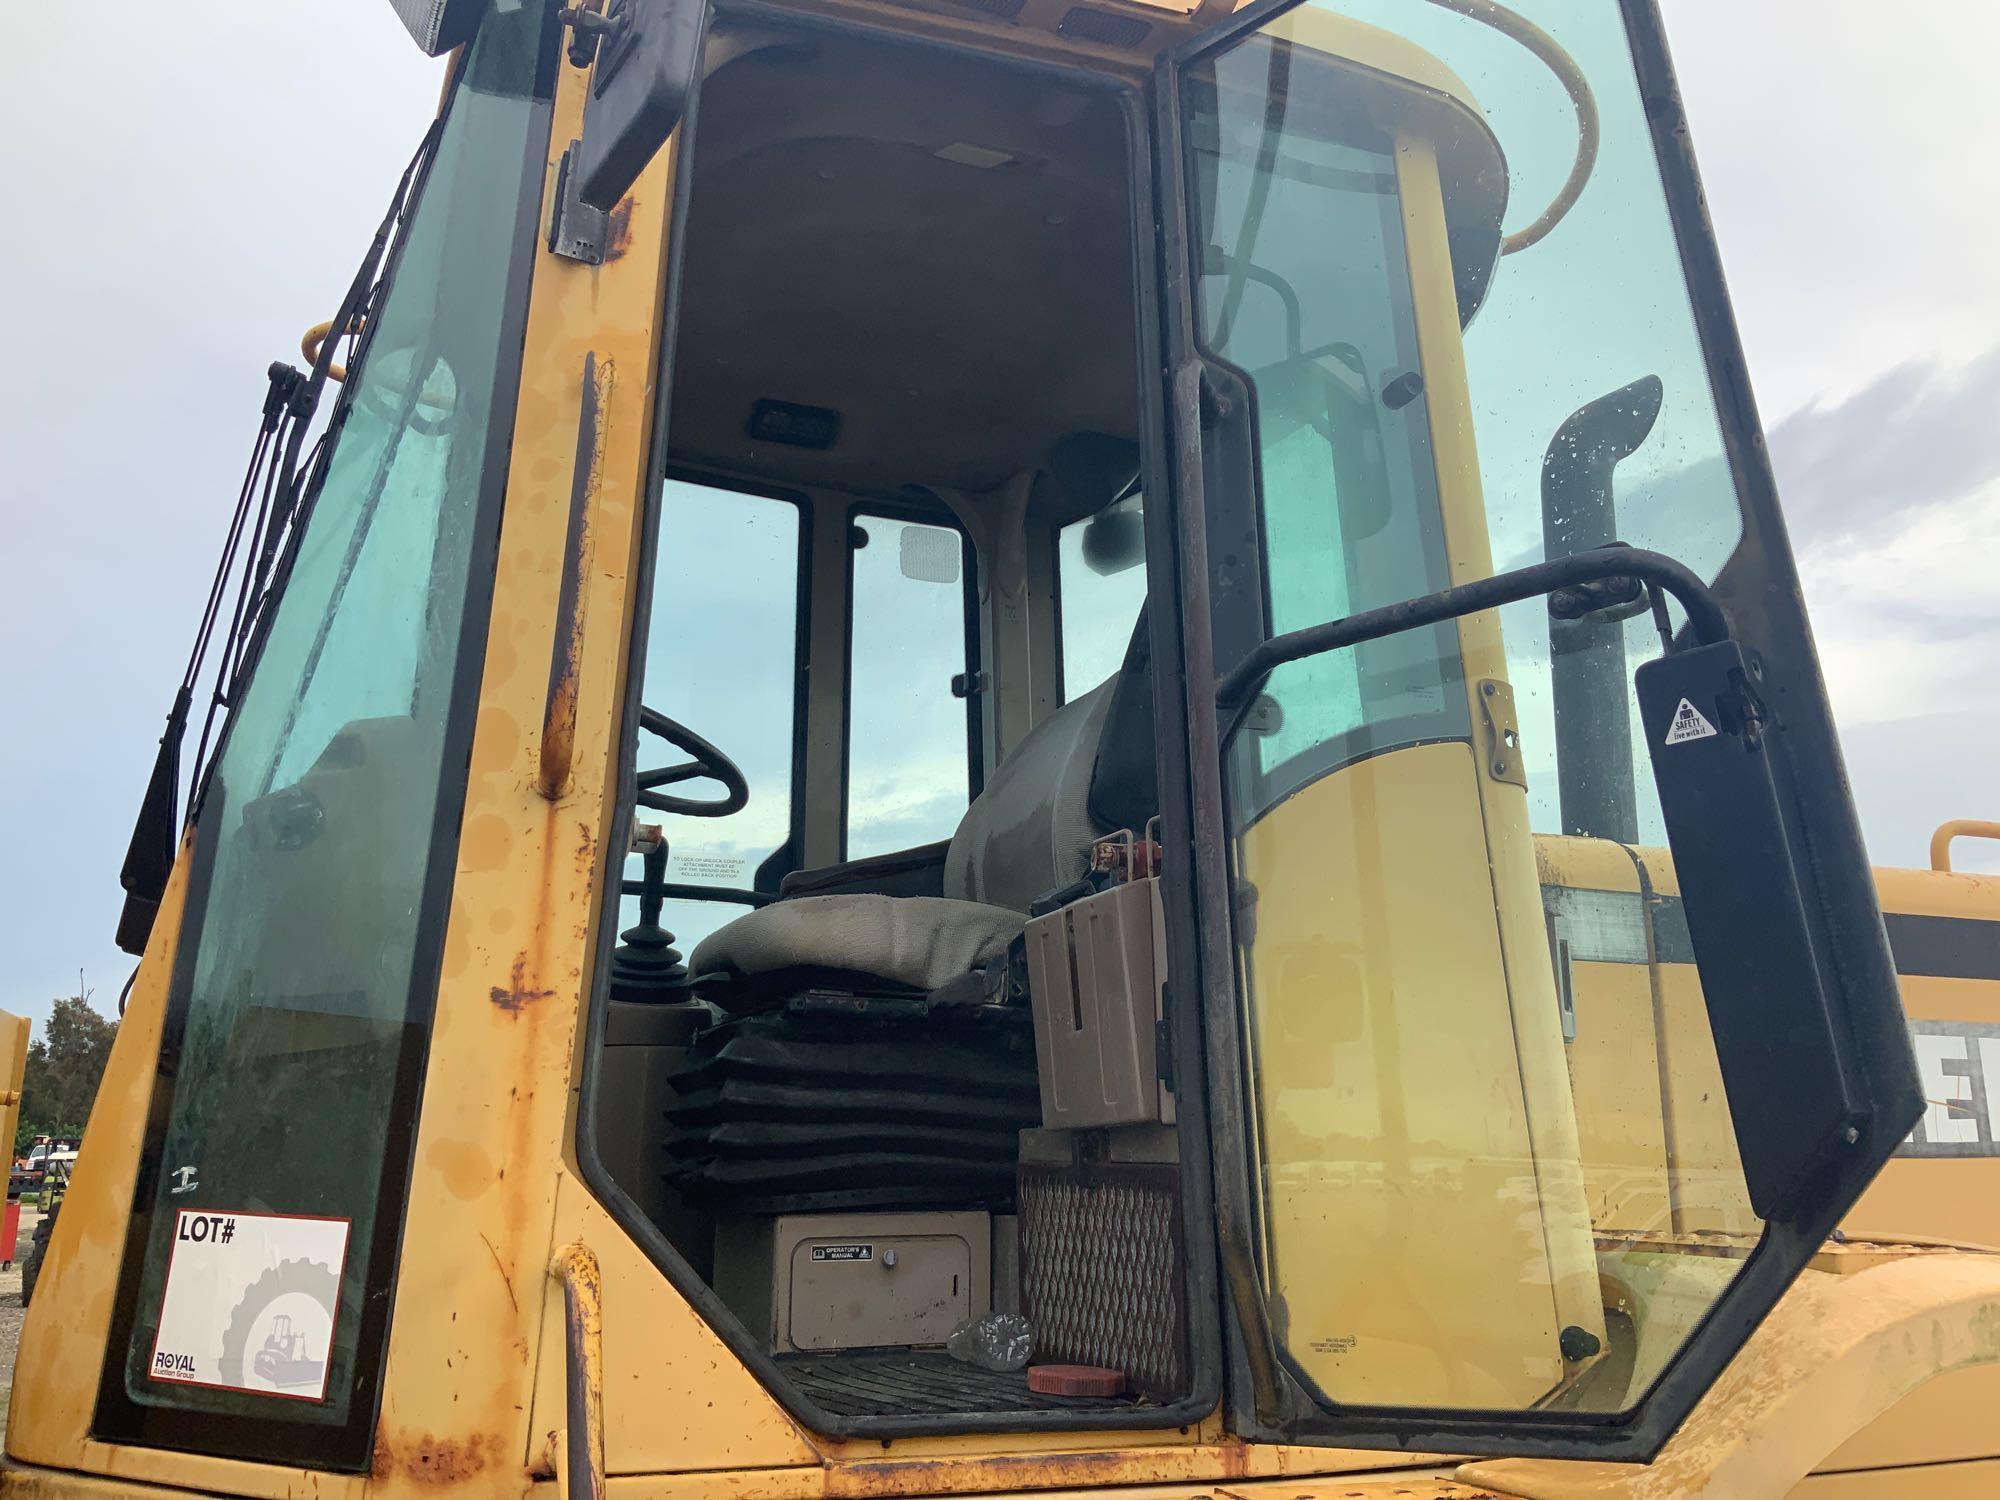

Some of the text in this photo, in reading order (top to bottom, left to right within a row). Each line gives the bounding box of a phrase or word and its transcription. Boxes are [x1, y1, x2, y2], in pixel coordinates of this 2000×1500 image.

[178, 1215, 236, 1244] LOT#
[155, 1352, 195, 1372] ROYAL
[153, 1367, 195, 1380] Auction Group
